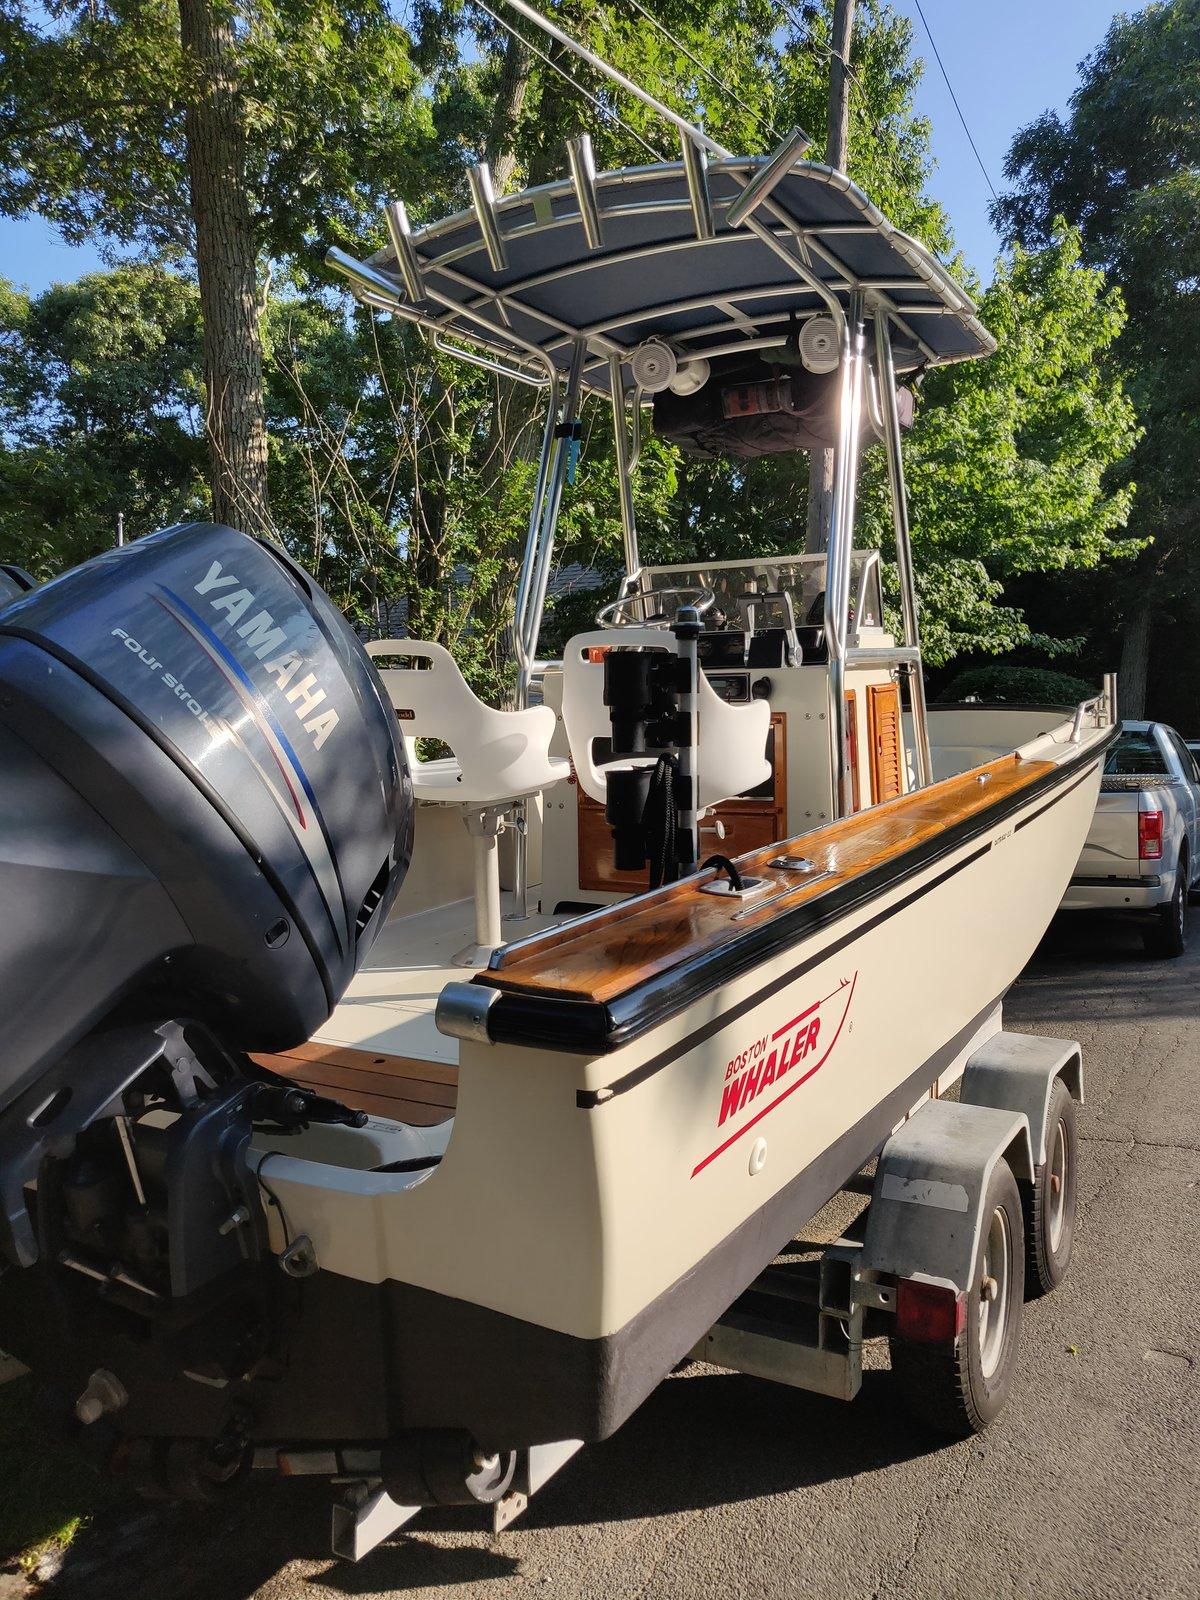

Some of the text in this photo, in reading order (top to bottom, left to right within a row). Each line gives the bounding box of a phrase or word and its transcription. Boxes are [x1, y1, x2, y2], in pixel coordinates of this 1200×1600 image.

[193, 560, 341, 751] YAMAHA
[717, 1016, 821, 1128] WHALER
[724, 1034, 769, 1081] BOSTON
